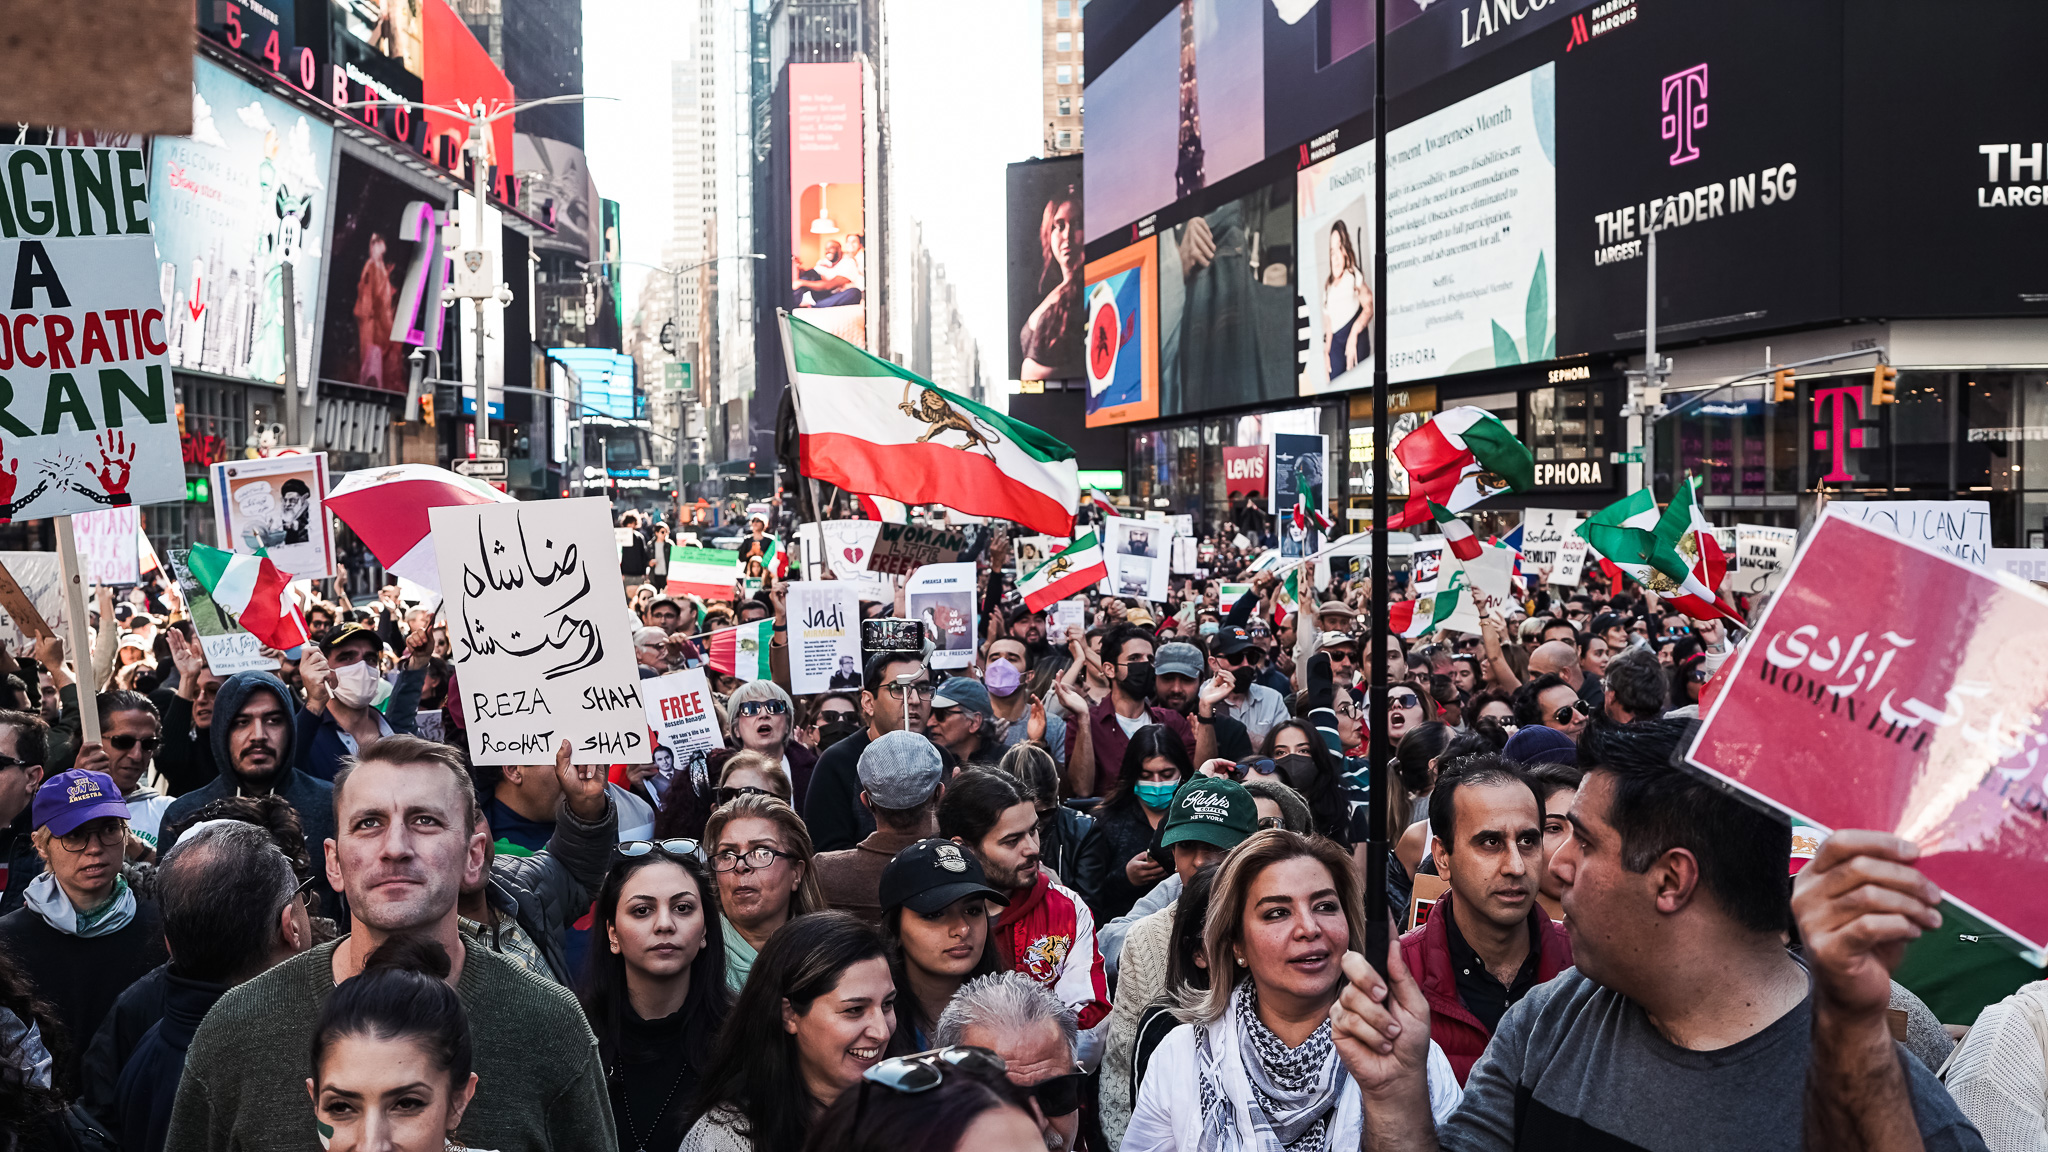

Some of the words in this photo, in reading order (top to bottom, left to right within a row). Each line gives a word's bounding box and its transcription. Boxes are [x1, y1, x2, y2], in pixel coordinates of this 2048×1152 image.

[1592, 6, 1637, 36] MARQUIS
[333, 64, 522, 207] BROADAY
[1329, 166, 1365, 191] Disability
[1368, 144, 1421, 176] Eloyment
[1425, 124, 1474, 152] Awareness
[1476, 104, 1511, 131] Month
[1979, 142, 2048, 183] TH
[1595, 206, 1635, 245] THE
[1639, 183, 1725, 236] LEADER
[1730, 173, 1755, 214] IN
[1760, 162, 1797, 206] 5G
[1594, 240, 1643, 266] LARGEST.
[11, 241, 72, 309] A
[1389, 348, 1436, 368] SEPHORA
[1548, 366, 1590, 383] SEPHORA
[1534, 462, 1602, 486] EPHORA
[1546, 512, 1553, 526] 1
[1923, 507, 1989, 541] CAN'T
[882, 522, 962, 552] WOMAN
[889, 541, 941, 564] LIFE
[1750, 545, 1777, 557] IRAN
[801, 588, 844, 612] FREE
[803, 602, 845, 632] Jadi
[1766, 624, 1916, 698] آزادی
[473, 688, 551, 723] REZA
[582, 684, 642, 711] SHAH
[660, 691, 704, 721] FREE
[579, 731, 641, 755] SHAD
[67, 784, 87, 798] SUN
[87, 782, 100, 791] RA
[69, 791, 103, 803] ARKESTRA
[1182, 790, 1230, 808] Ralph's
[131, 829, 158, 848] REEDO
